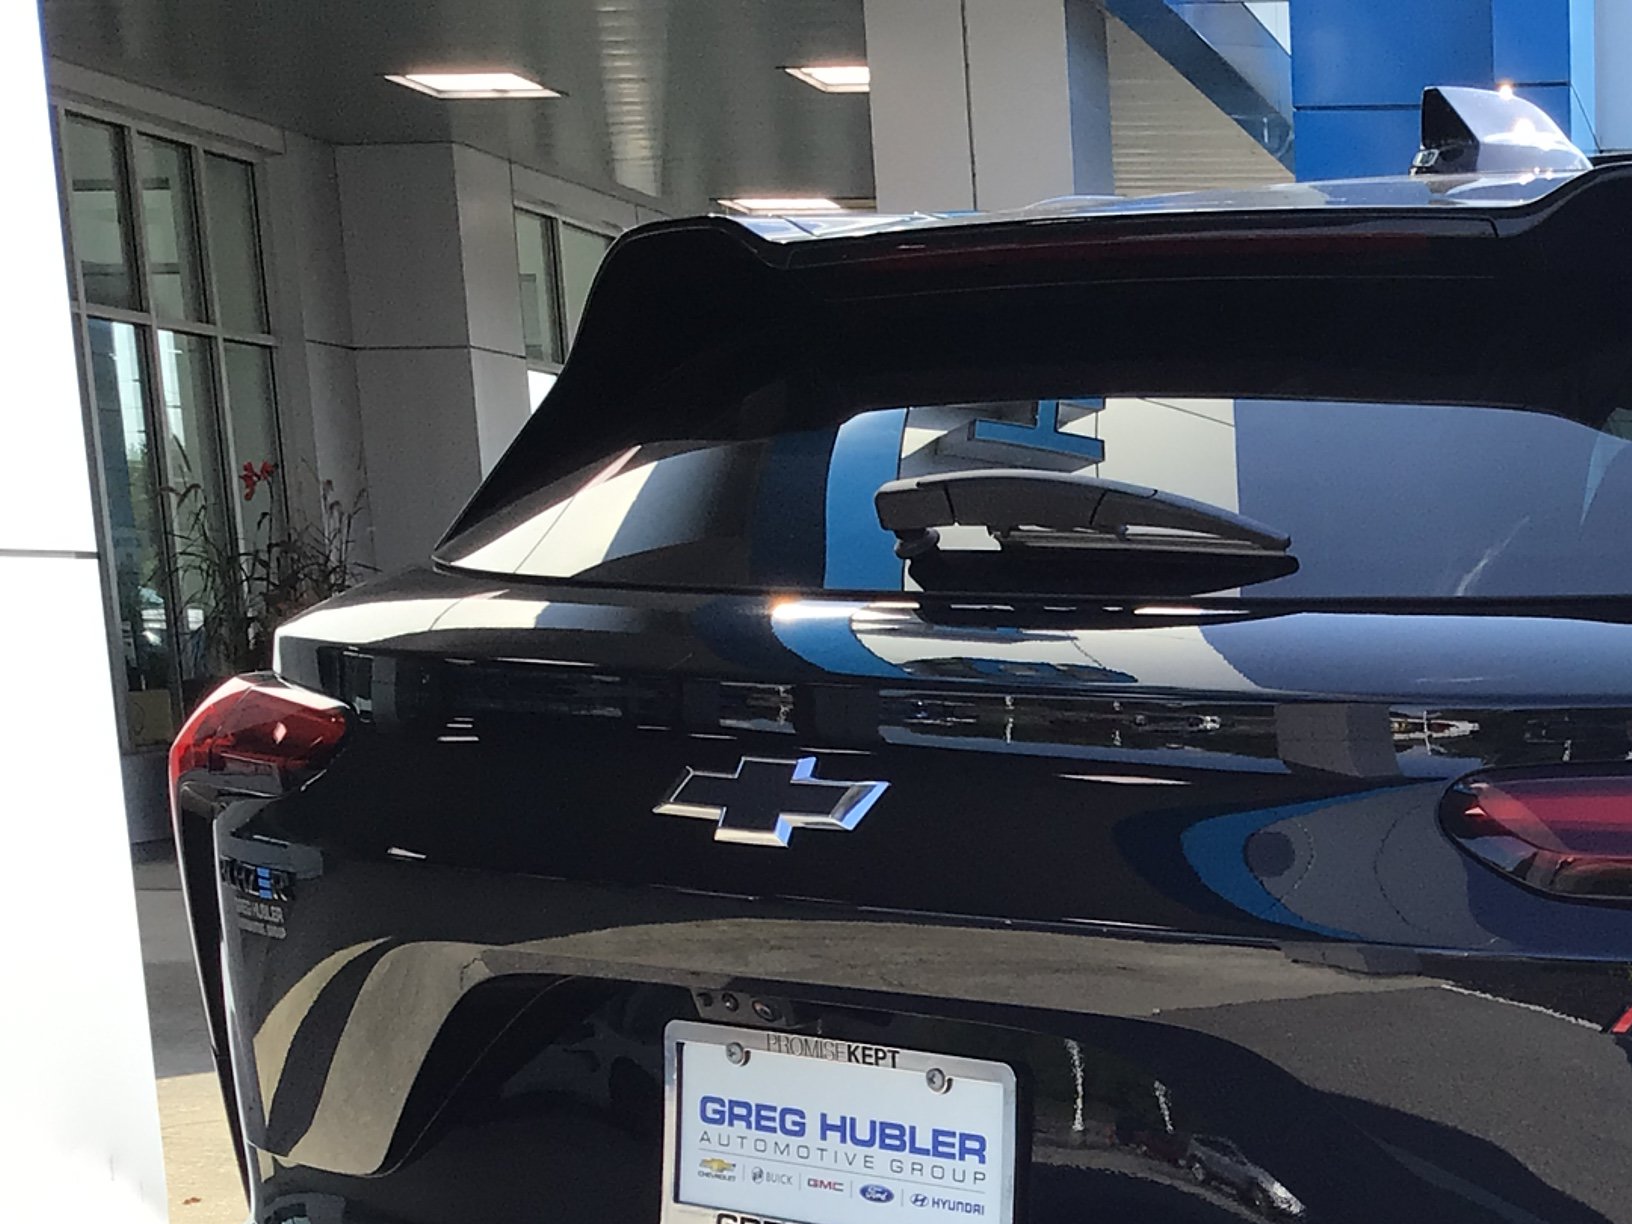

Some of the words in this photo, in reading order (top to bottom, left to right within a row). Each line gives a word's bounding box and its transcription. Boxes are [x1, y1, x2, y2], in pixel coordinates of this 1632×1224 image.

[699, 1095, 806, 1137] GREG
[820, 1112, 987, 1164] HUBLER
[699, 1130, 875, 1170] AUTOMOTIVE
[890, 1158, 986, 1185] GROUP
[765, 1173, 793, 1186] BUICK
[807, 1178, 844, 1192] GMC
[931, 1197, 985, 1216] HYUNDAI
